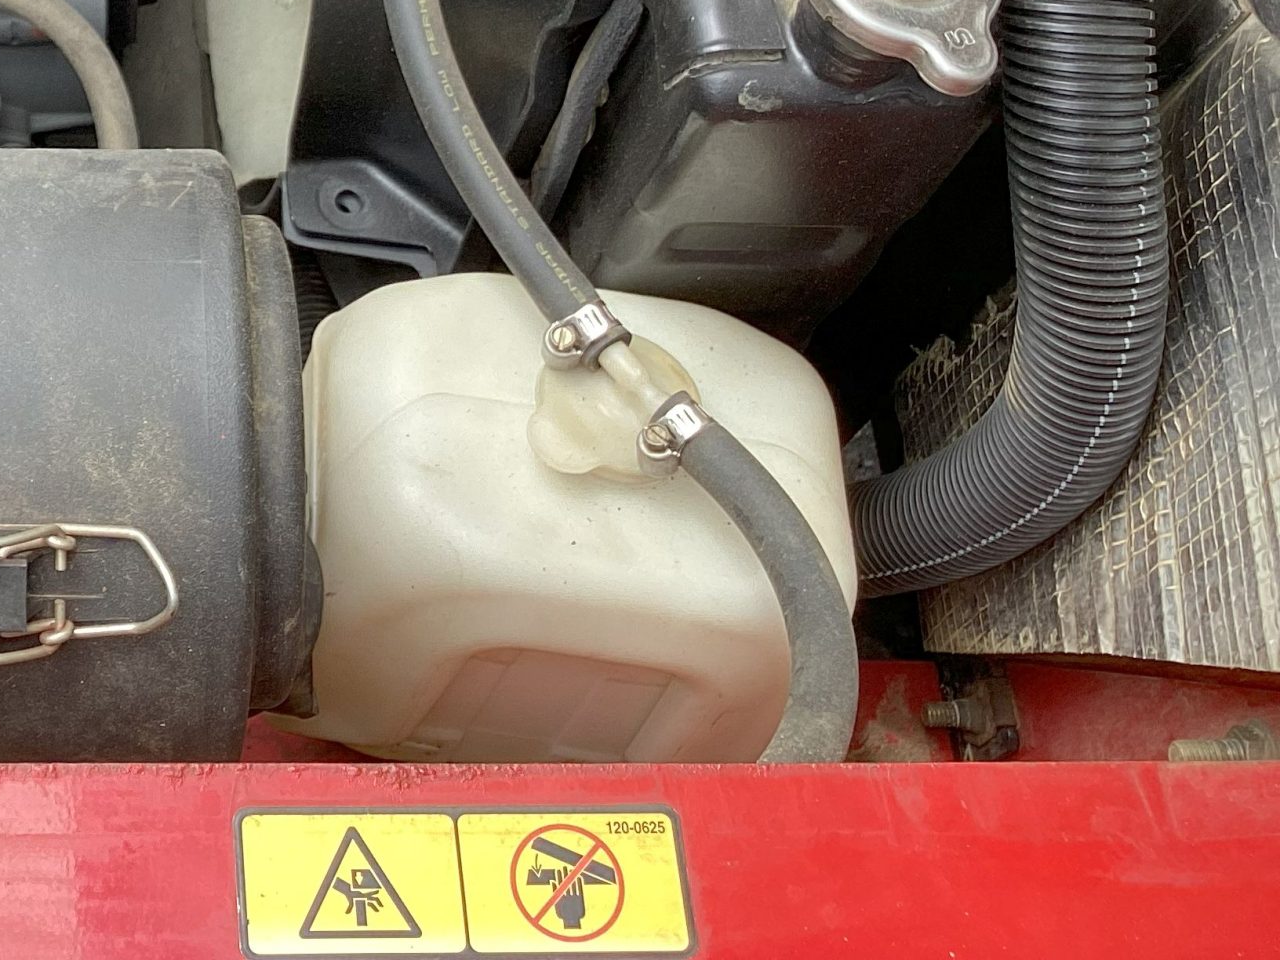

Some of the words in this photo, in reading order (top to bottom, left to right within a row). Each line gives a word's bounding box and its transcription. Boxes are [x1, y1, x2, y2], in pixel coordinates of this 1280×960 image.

[437, 70, 460, 112] LOW
[462, 125, 529, 230] STANDARD
[606, 820, 666, 834] 120-0625
